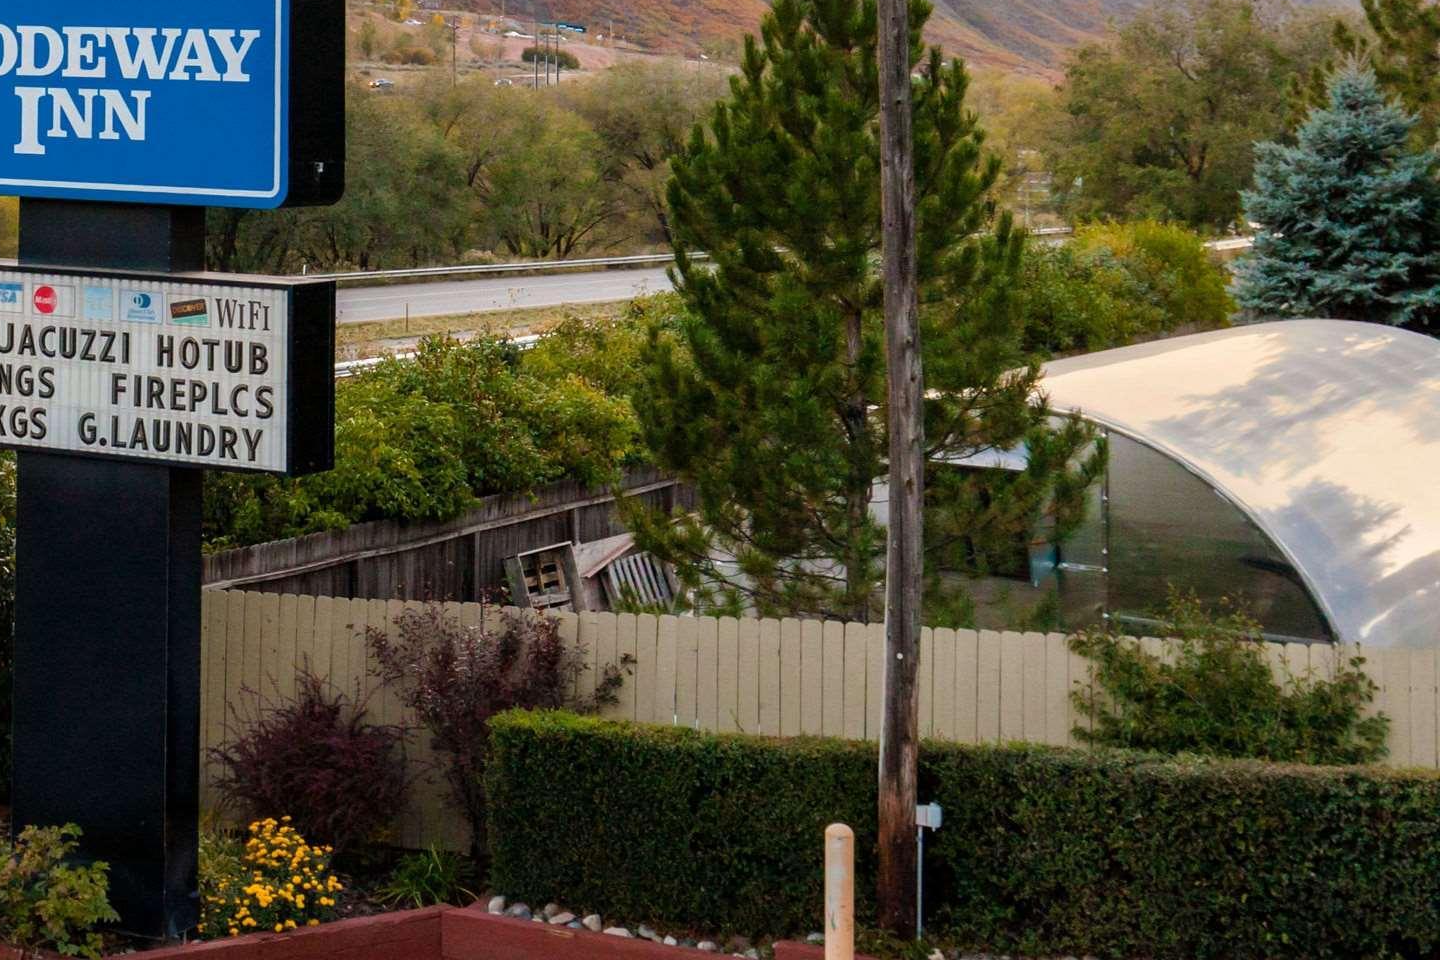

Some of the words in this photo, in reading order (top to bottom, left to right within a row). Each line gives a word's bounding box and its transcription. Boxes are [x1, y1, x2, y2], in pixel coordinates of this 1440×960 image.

[13, 86, 151, 155] INN
[157, 334, 269, 375] HOTUB
[111, 373, 274, 419] FIREPLCS
[78, 411, 264, 462] G.LAUNDRY
